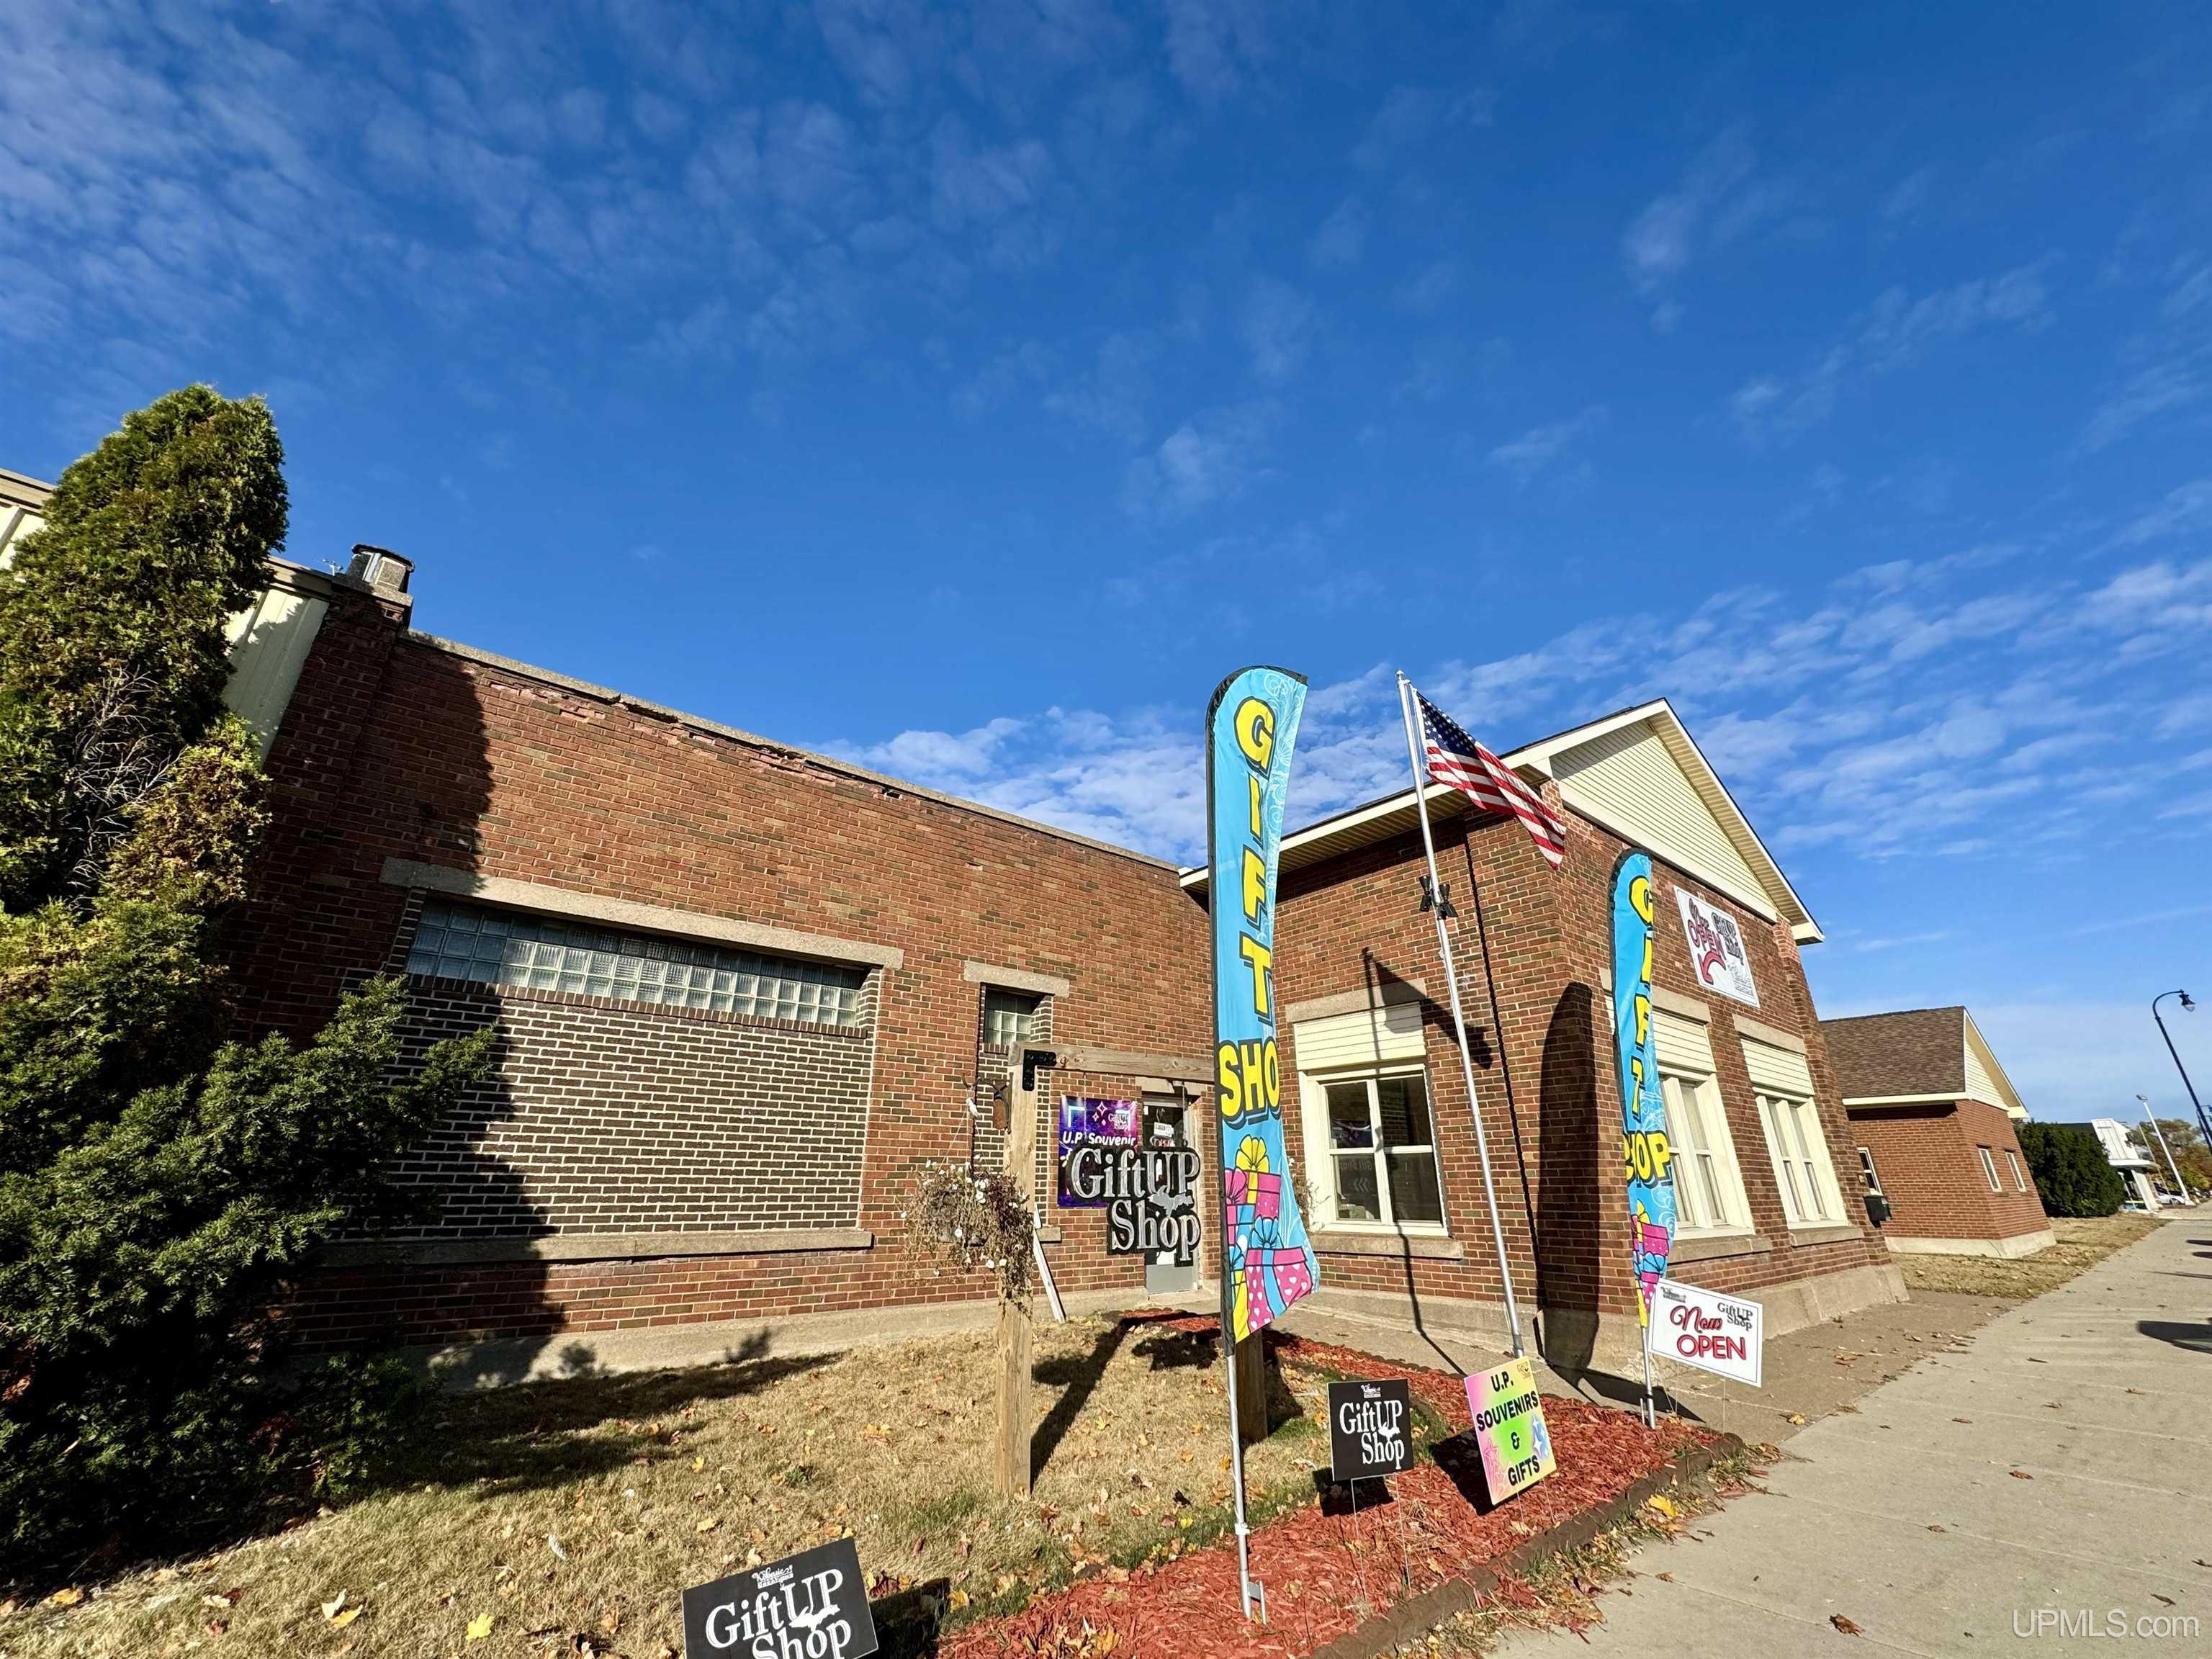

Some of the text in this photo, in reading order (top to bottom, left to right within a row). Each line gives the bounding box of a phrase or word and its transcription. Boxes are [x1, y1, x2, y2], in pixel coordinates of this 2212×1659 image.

[1234, 696, 1276, 1020] GIFT
[1688, 920, 1727, 960] OPEN
[1088, 1132, 1136, 1146] Souvenir
[1112, 1200, 1200, 1261] Shop
[1727, 1316, 1753, 1331] Shop
[1676, 1334, 1747, 1360] OPEN
[1491, 1370, 1514, 1392] U.P.
[1476, 1390, 1539, 1431] SOUVENIRS
[1362, 1432, 1405, 1470] Shop
[1511, 1431, 1521, 1450] &
[1508, 1457, 1540, 1487] GIFTS
[752, 1619, 852, 1659] Shop
